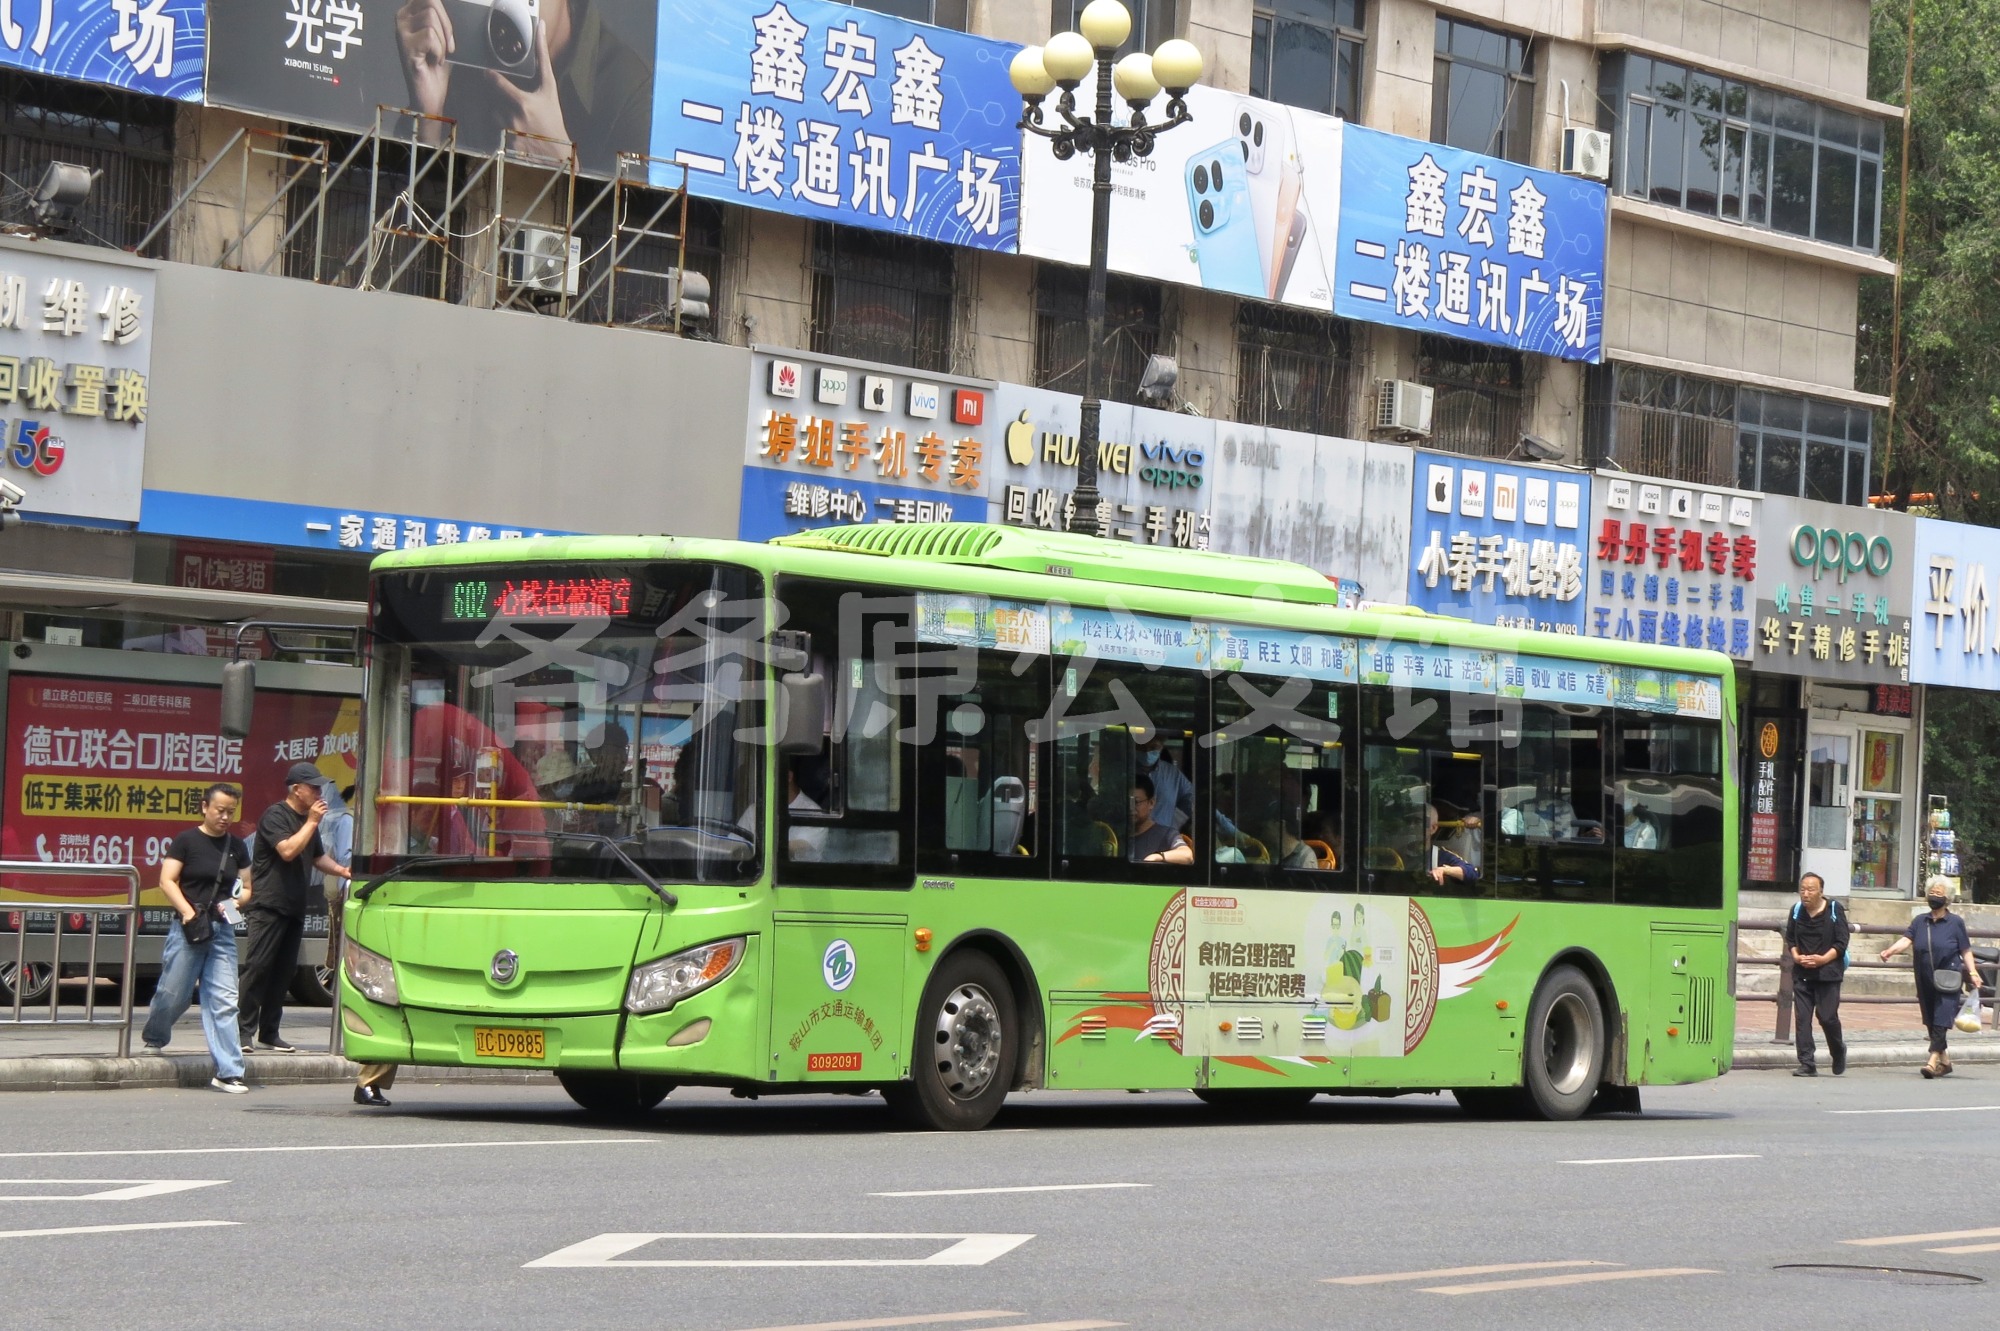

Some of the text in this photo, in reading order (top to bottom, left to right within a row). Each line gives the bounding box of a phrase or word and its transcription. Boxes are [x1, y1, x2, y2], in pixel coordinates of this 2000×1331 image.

[285, 0, 363, 59] 光学
[320, 65, 333, 75] Ultra
[750, 2, 945, 131] 鑫宏鑫
[674, 101, 1001, 236] 二楼通讯广场
[1405, 152, 1547, 260] 鑫宏鑫
[1350, 238, 1589, 349] 二楼通讯广场
[0, 356, 148, 423] 回收置换
[777, 386, 795, 396] HUAWEI
[914, 392, 936, 410] vivo
[10, 419, 66, 477] 5G
[762, 409, 983, 489] 婷姐手机专卖
[1042, 432, 1134, 475] HUWEI
[1140, 439, 1204, 467] vivo
[1140, 466, 1204, 490] oppo
[787, 482, 952, 524] 维修中心 二手回收
[1463, 498, 1483, 508] HUAWEI
[1527, 496, 1547, 508] vivo
[1644, 492, 1660, 500] HONOR
[1735, 508, 1750, 518] vivo
[1418, 531, 1583, 601] 小春手机维修
[1598, 518, 1756, 582] 丹丹手机专卖
[1791, 524, 1893, 584] oppo
[454, 581, 487, 618] 602
[1600, 569, 1745, 612] 回收销售二手机
[1775, 583, 1889, 626] 收售二手机
[1925, 553, 2000, 656] 平价
[1082, 619, 1183, 648] 社会主义核心价值观
[1759, 616, 1903, 667] 华子精修手机
[1226, 637, 1343, 670] 富强 民主 文明 和谐
[1373, 652, 1482, 682] 自由 平等 公正 法治
[1505, 666, 1605, 695] 爱国 敬业 诚信 友善
[42, 688, 113, 705] 德立联合口腔医院
[124, 693, 192, 709] 二级口腔专科医院
[24, 724, 243, 775] 德立联合口腔医院
[274, 737, 319, 762] 大医院
[1759, 761, 1776, 780] 手机
[25, 780, 208, 816] 低于集采价 种全口德
[1758, 779, 1774, 796] 配件
[58, 847, 89, 864] 0412
[93, 834, 134, 865] 661
[59, 834, 90, 846] 咨询热线
[1198, 941, 1295, 968] 食物合理搭配
[1209, 971, 1306, 998] 拒绝餐饮浪费
[788, 999, 883, 1052] 鞍山市交通运输集团
[811, 1056, 858, 1069] 3092091
